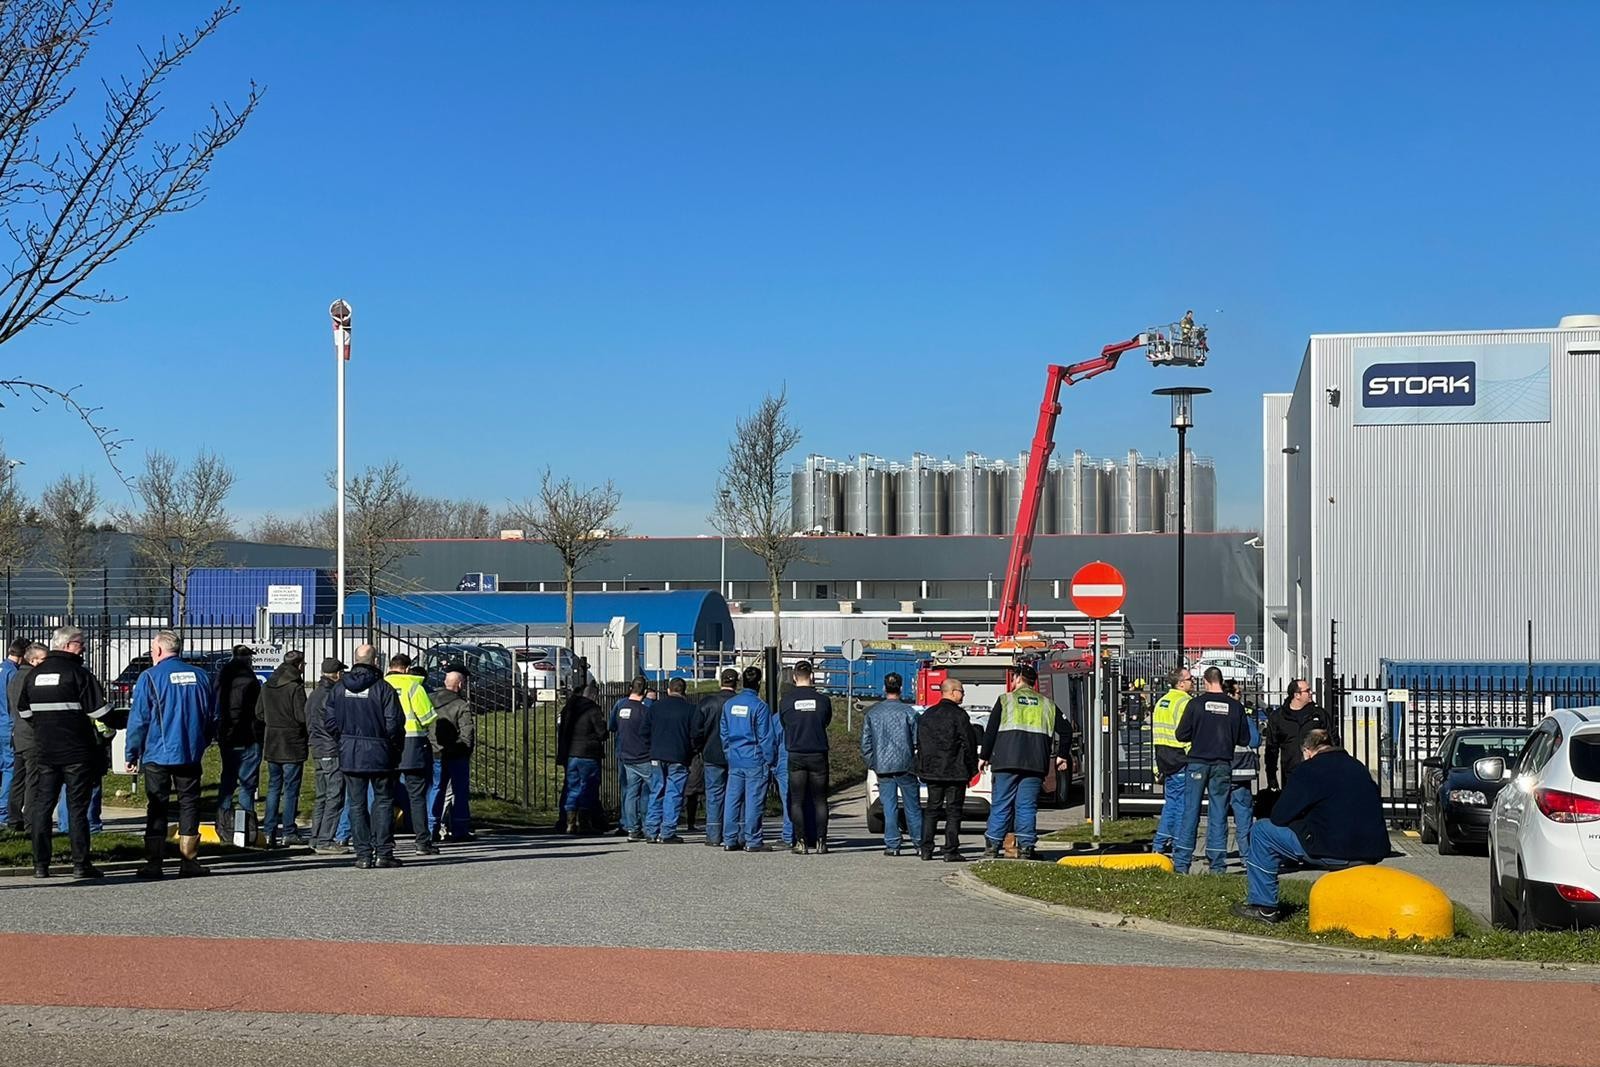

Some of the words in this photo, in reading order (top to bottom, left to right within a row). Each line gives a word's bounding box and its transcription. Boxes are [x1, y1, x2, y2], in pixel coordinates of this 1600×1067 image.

[1368, 375, 1470, 395] STORK
[251, 646, 281, 655] rkeren
[1354, 694, 1382, 702] 18034
